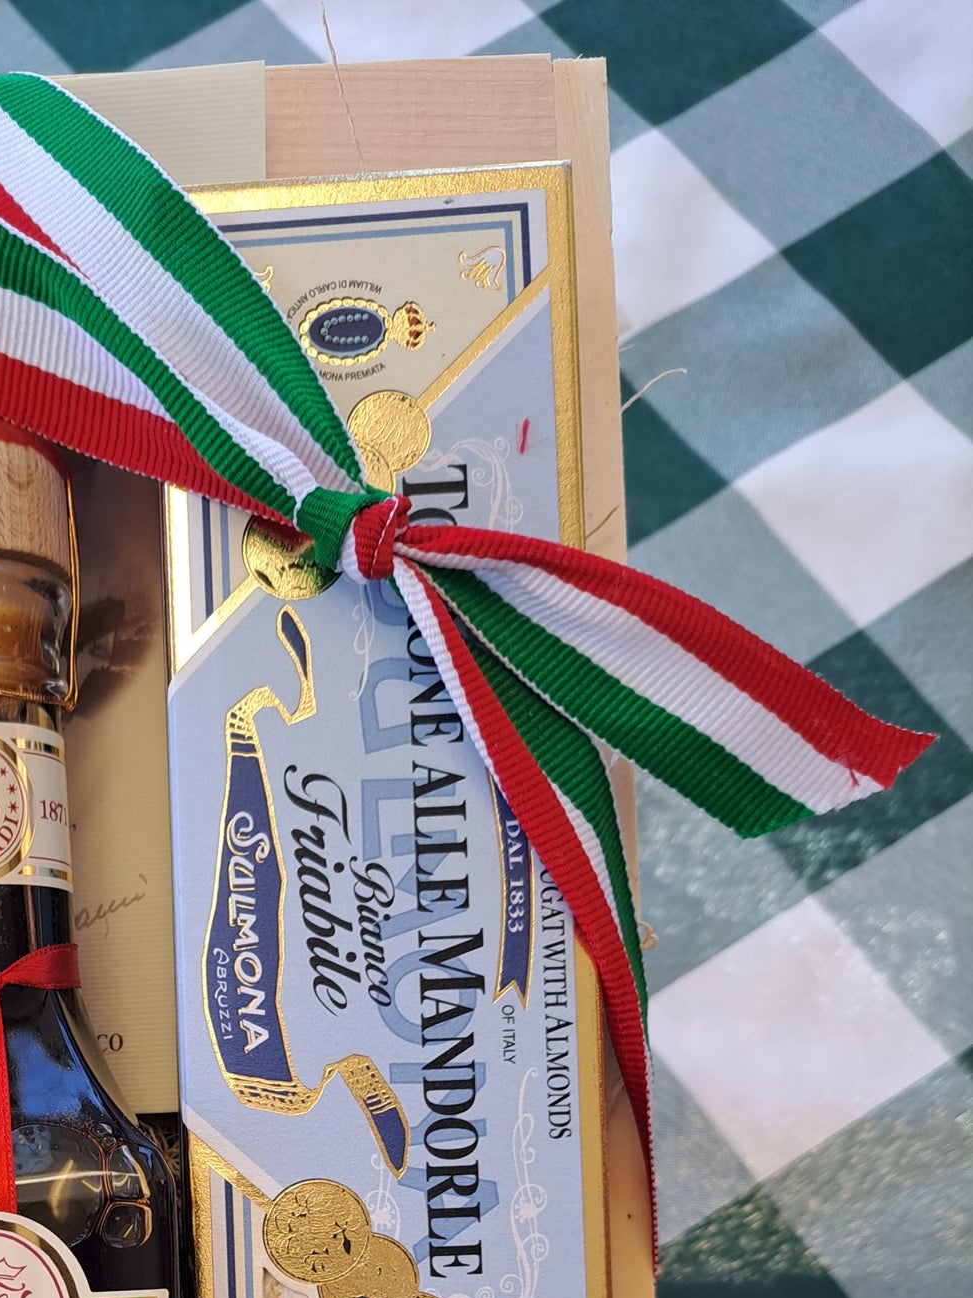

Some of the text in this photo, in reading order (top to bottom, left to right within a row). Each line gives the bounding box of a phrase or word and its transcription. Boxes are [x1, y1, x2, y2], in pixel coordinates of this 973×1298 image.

[344, 362, 387, 381] PREMIATA
[284, 765, 361, 1018] Friabile
[412, 760, 469, 914] ALLE
[225, 810, 271, 1054] SULMONA
[348, 855, 396, 1008] Bianco
[508, 878, 525, 934] 1833
[213, 947, 233, 1040] ABRUZZI
[501, 1004, 517, 1065] OF ITALY
[541, 942, 568, 1008] WITH
[418, 927, 486, 1279] MANDORLE
[544, 1013, 575, 1140] ALMONDS
